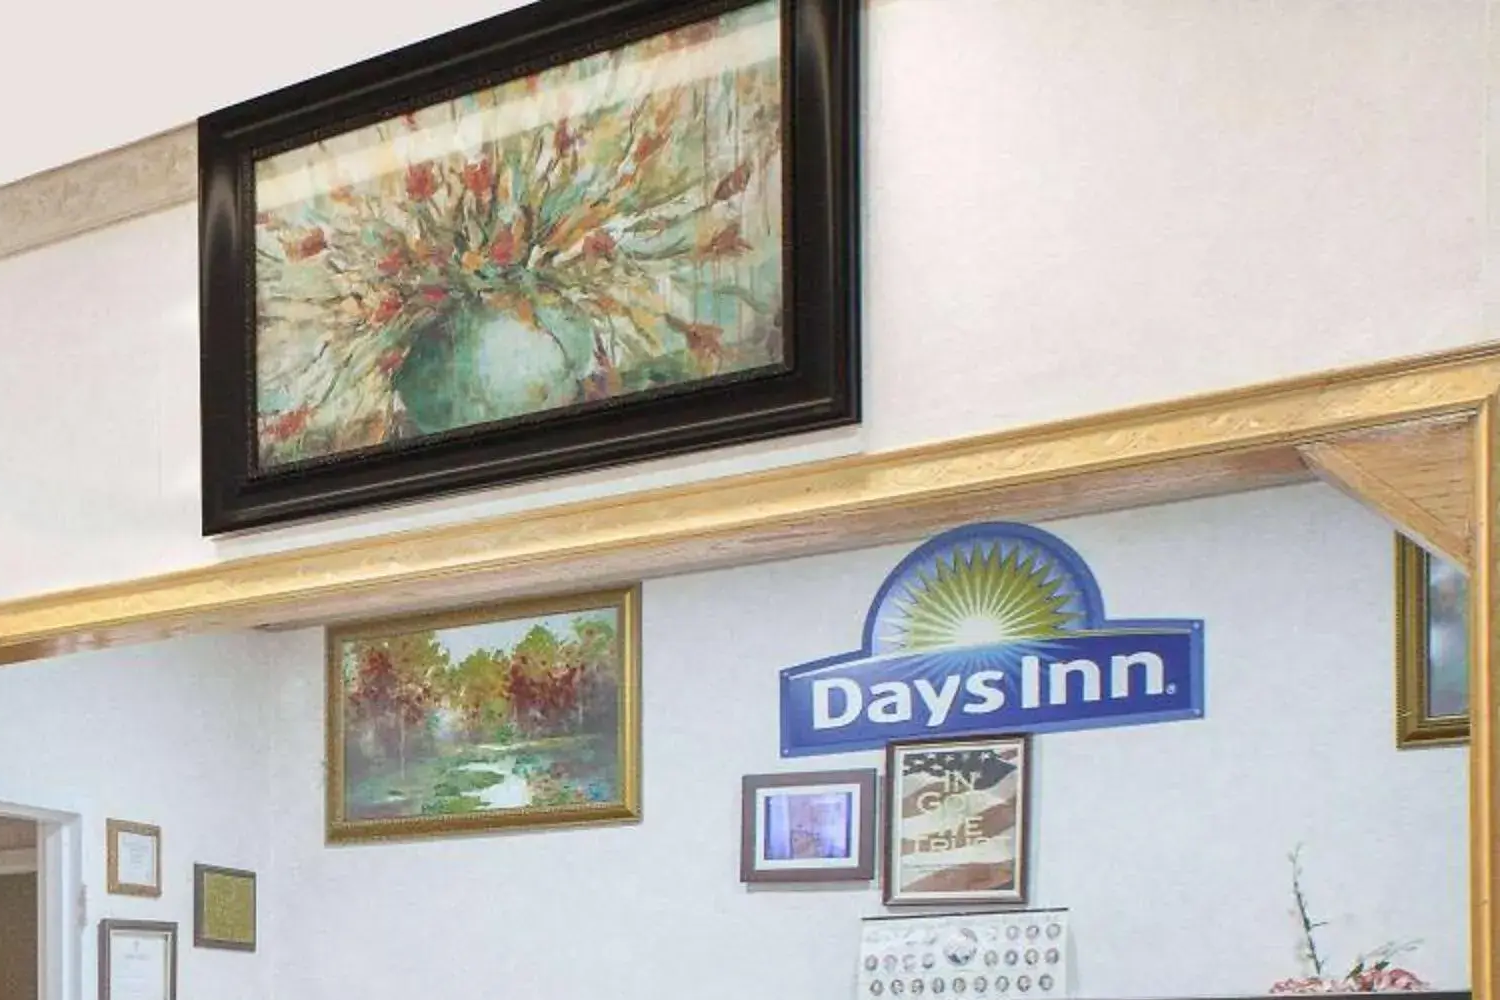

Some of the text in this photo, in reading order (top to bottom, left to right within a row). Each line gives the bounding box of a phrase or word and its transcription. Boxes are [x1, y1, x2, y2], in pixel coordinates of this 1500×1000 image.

[812, 650, 1164, 730] Days Inn
[942, 769, 982, 793] IN
[916, 790, 992, 816] GO
